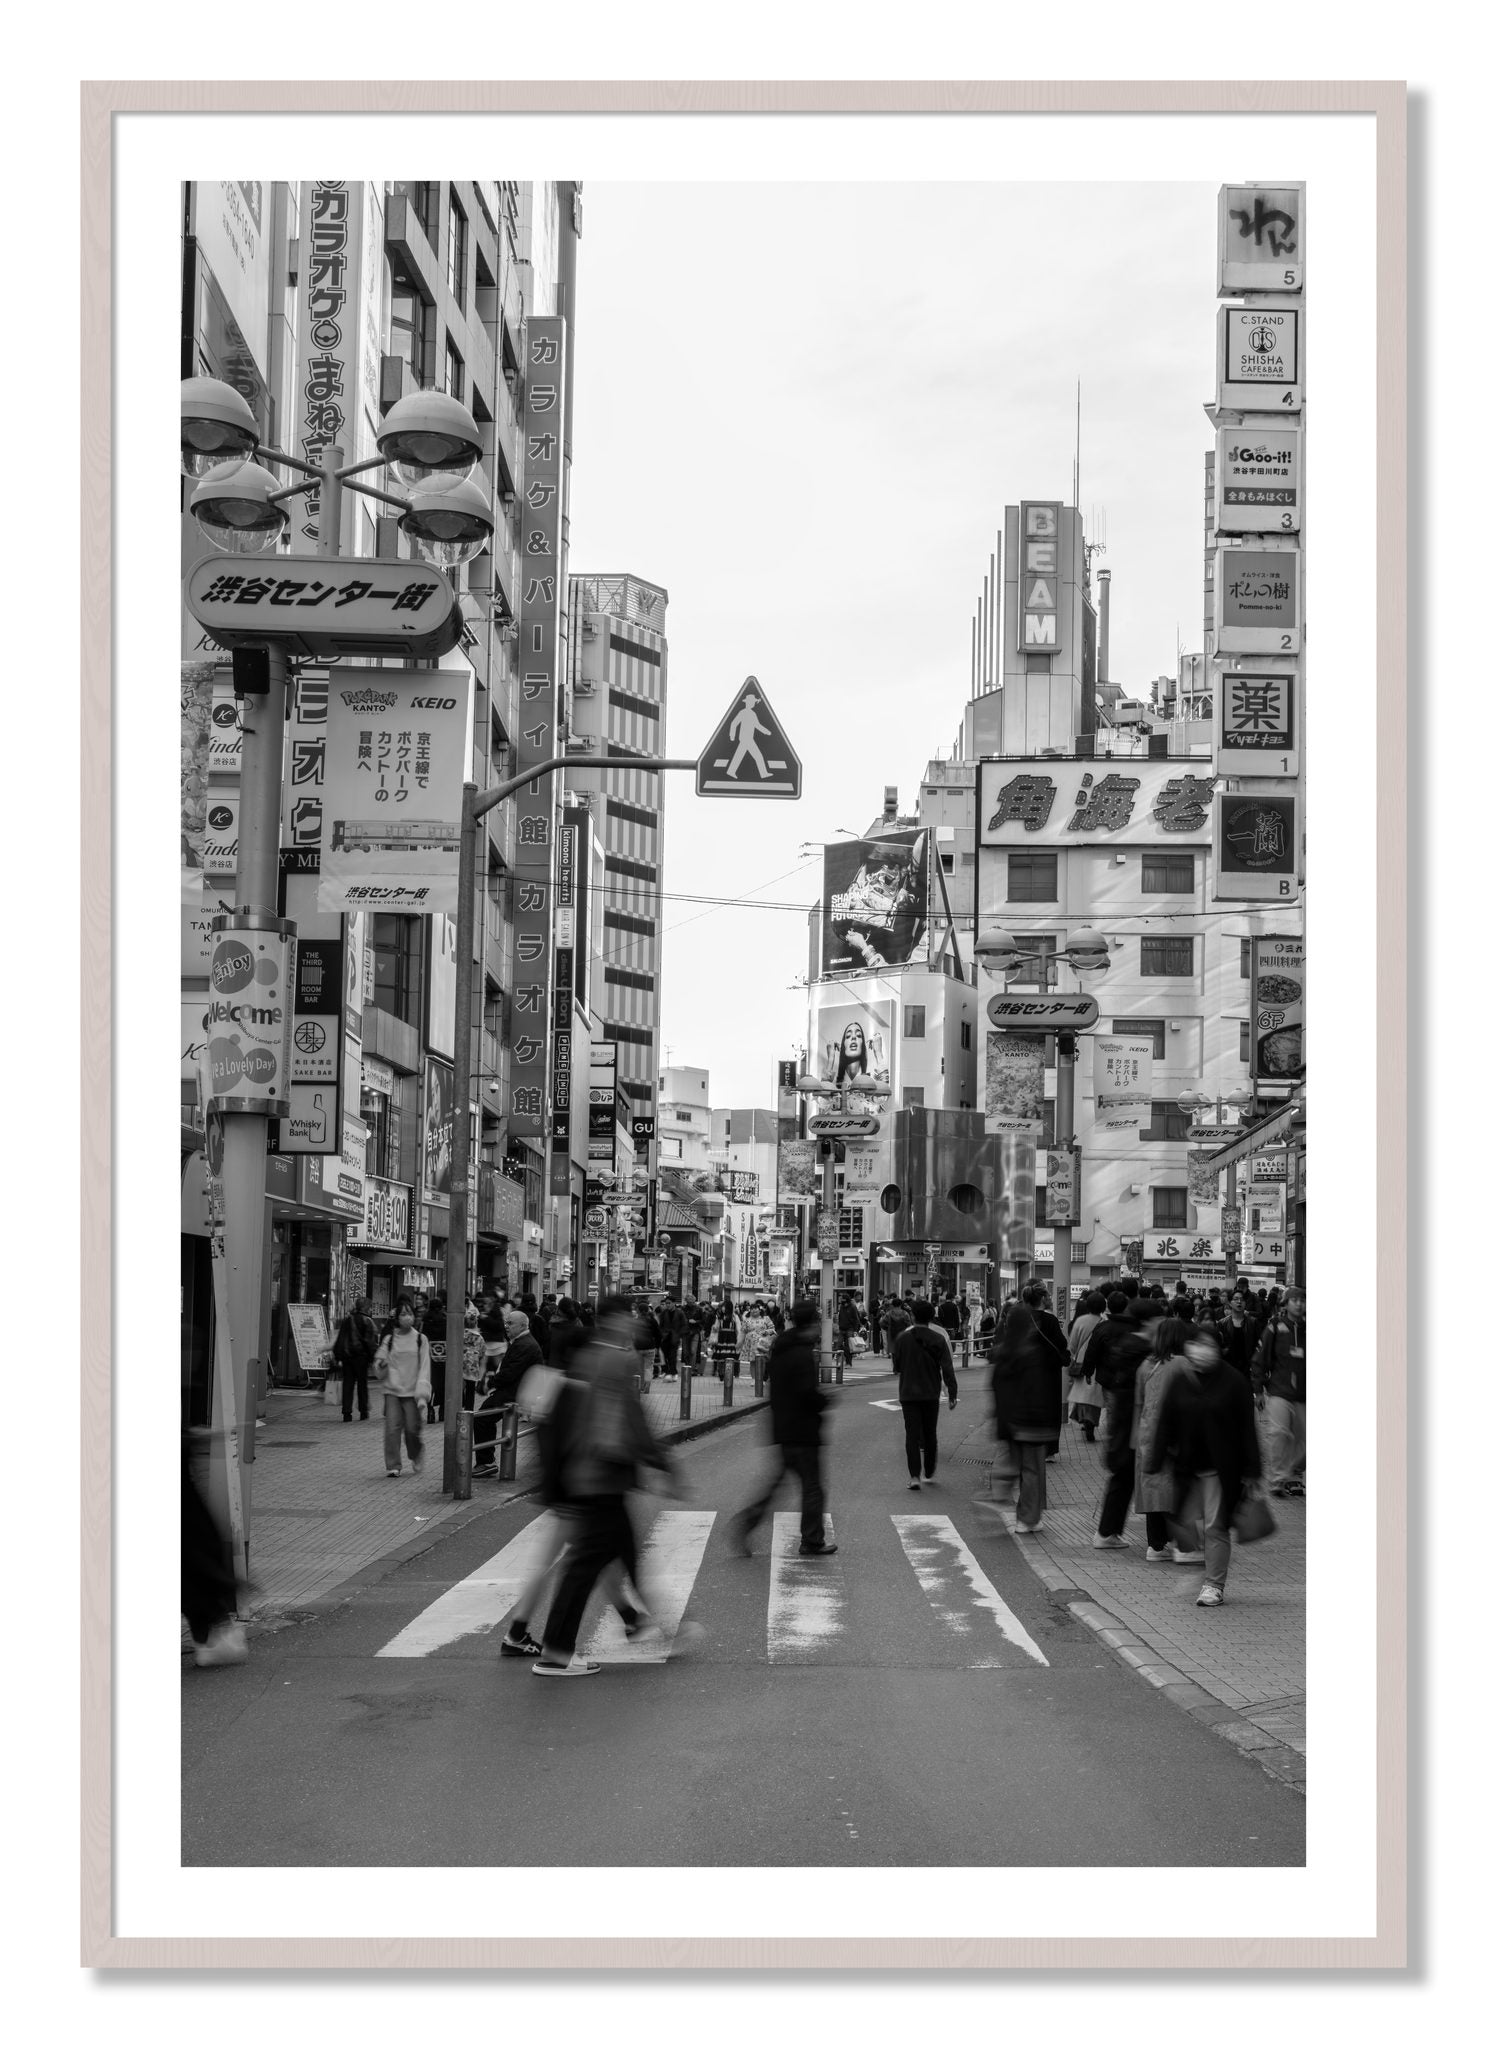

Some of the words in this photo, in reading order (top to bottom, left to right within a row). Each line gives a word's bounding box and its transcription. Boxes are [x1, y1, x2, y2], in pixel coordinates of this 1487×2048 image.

[309, 188, 349, 321] カラオケ
[1284, 271, 1295, 285] 5
[1241, 316, 1285, 325] C.STAND
[1241, 355, 1283, 365] SHISHA
[1241, 365, 1284, 374] CAFE&BAR
[1240, 448, 1292, 464] Goo-it!
[1233, 467, 1288, 476] 渋谷宇田川町店
[1228, 491, 1293, 503] 全身もみほぐし
[1281, 513, 1293, 528] 3
[1025, 507, 1056, 644] BEAM
[200, 575, 439, 612] 渋谷センター街
[1239, 603, 1282, 611] Pomme-no-ki
[1281, 635, 1292, 649] 2
[410, 697, 457, 710] KEIO
[1232, 681, 1281, 729] 薬
[1226, 732, 1286, 748] マツモトキヨシ
[357, 731, 372, 772] 冒険へ
[213, 758, 236, 766] 渋谷店
[375, 731, 392, 802] カントーの
[394, 731, 411, 802] ポケパーク
[415, 732, 431, 789] 京王線で
[1281, 758, 1288, 772] 1
[562, 831, 571, 865] kimono
[345, 887, 430, 899] 渋谷センター街
[561, 869, 570, 902] hearts
[1280, 881, 1290, 895] B
[212, 953, 251, 986] Enjoy
[1259, 956, 1302, 968] 四川料理
[512, 883, 546, 1116] カラオケ館
[209, 1001, 282, 1025] Welcome
[994, 1003, 1093, 1015] 渋谷センター街
[1257, 1011, 1285, 1031] 6F
[226, 1057, 254, 1075] Lovely
[256, 1057, 275, 1072] Day!
[290, 1120, 321, 1130] Whisky
[634, 1123, 653, 1133] GU
[811, 1120, 871, 1128] 渋谷センター街
[747, 1236, 756, 1276] BEER
